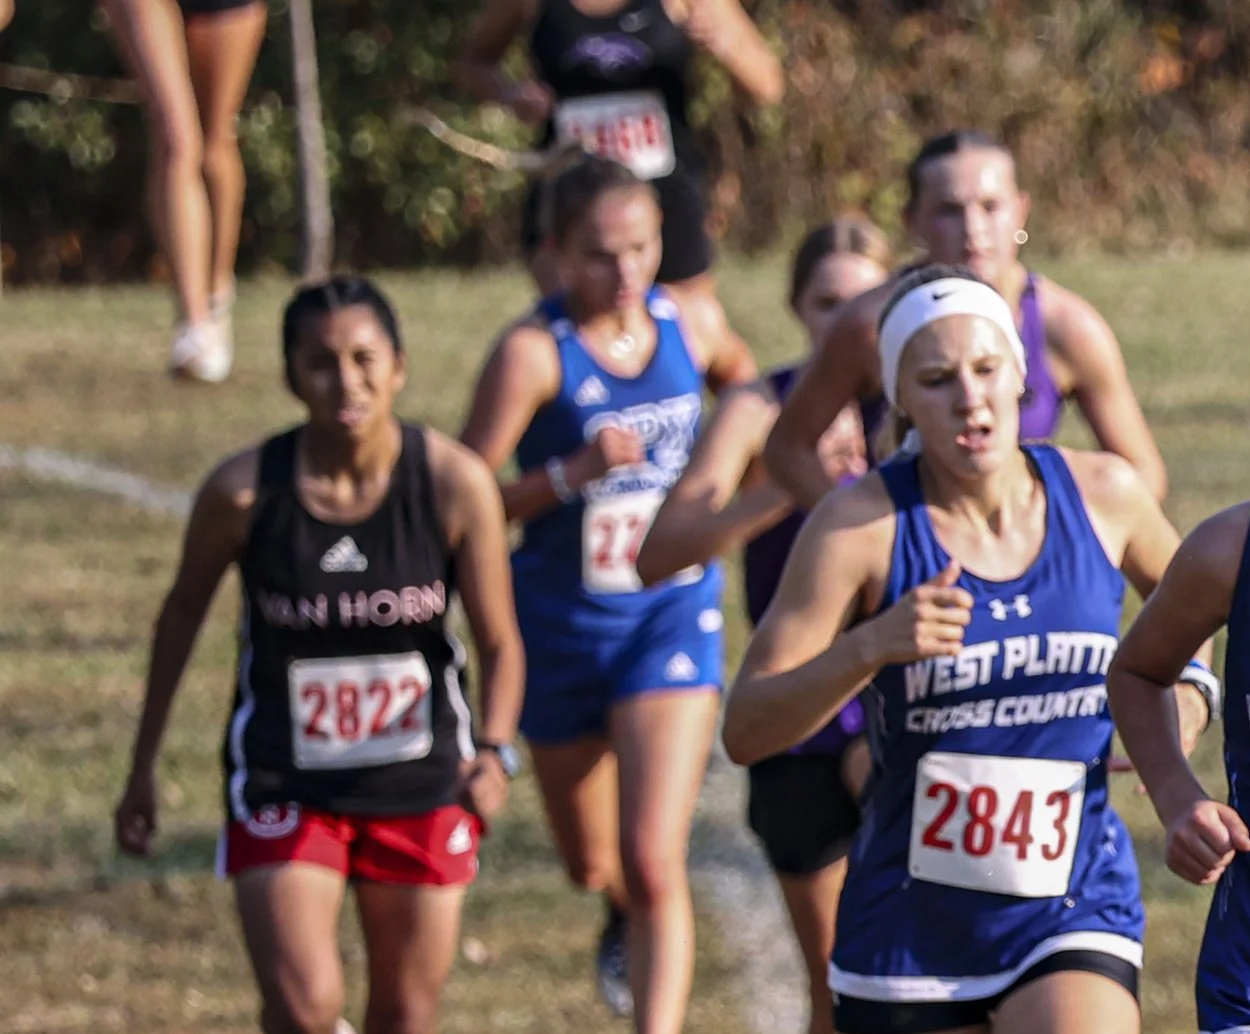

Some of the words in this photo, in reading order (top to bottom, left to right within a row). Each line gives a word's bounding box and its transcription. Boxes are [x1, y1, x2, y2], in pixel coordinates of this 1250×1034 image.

[339, 580, 446, 628] HORN
[904, 640, 1000, 703] WEST
[302, 676, 428, 742] 2822
[905, 699, 995, 734] CROSS
[921, 782, 1072, 861] 2843
